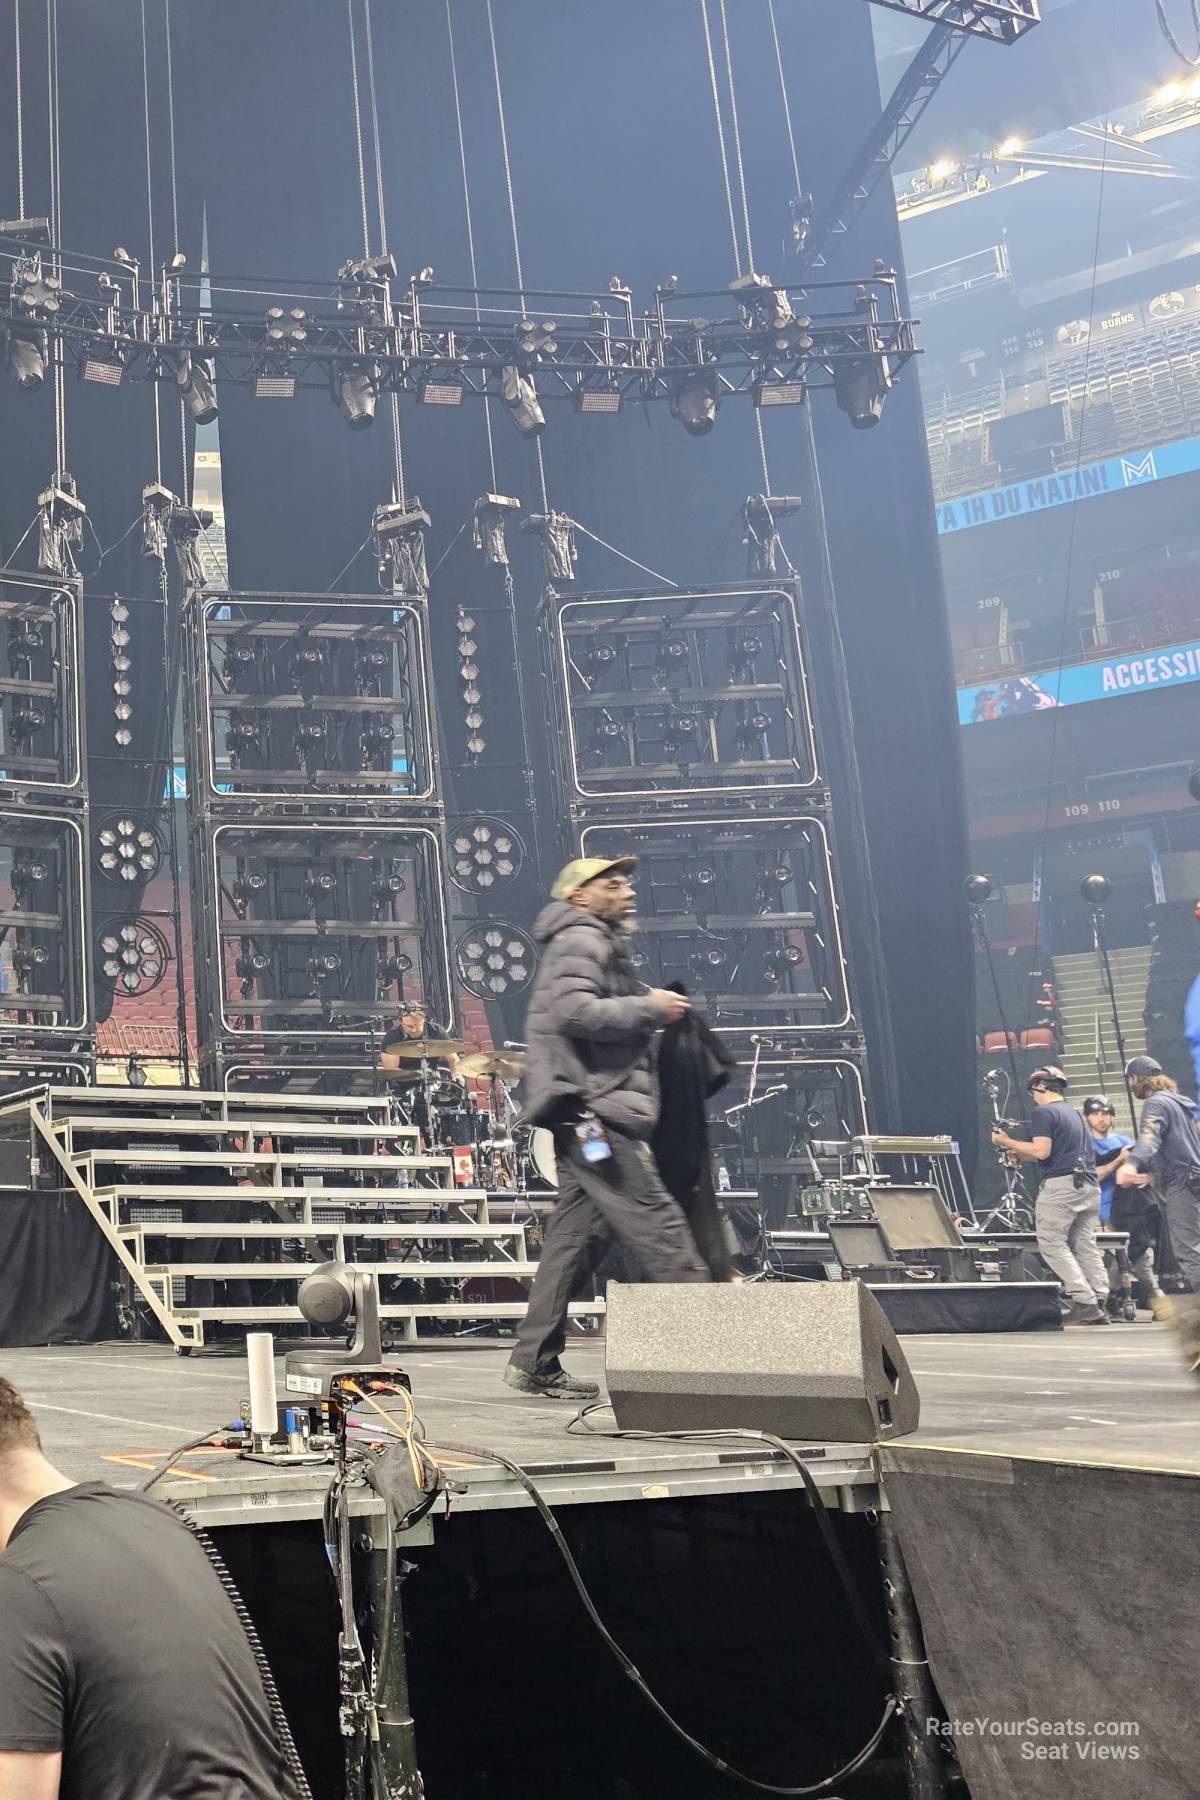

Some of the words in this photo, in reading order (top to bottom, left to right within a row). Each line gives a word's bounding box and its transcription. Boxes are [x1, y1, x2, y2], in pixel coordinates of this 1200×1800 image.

[1101, 313, 1135, 330] BURNS
[992, 487, 1022, 517] DU
[1026, 465, 1109, 508] MATIN!
[976, 596, 1000, 609] 209
[1064, 804, 1089, 817] 109
[1098, 799, 1120, 811] 110
